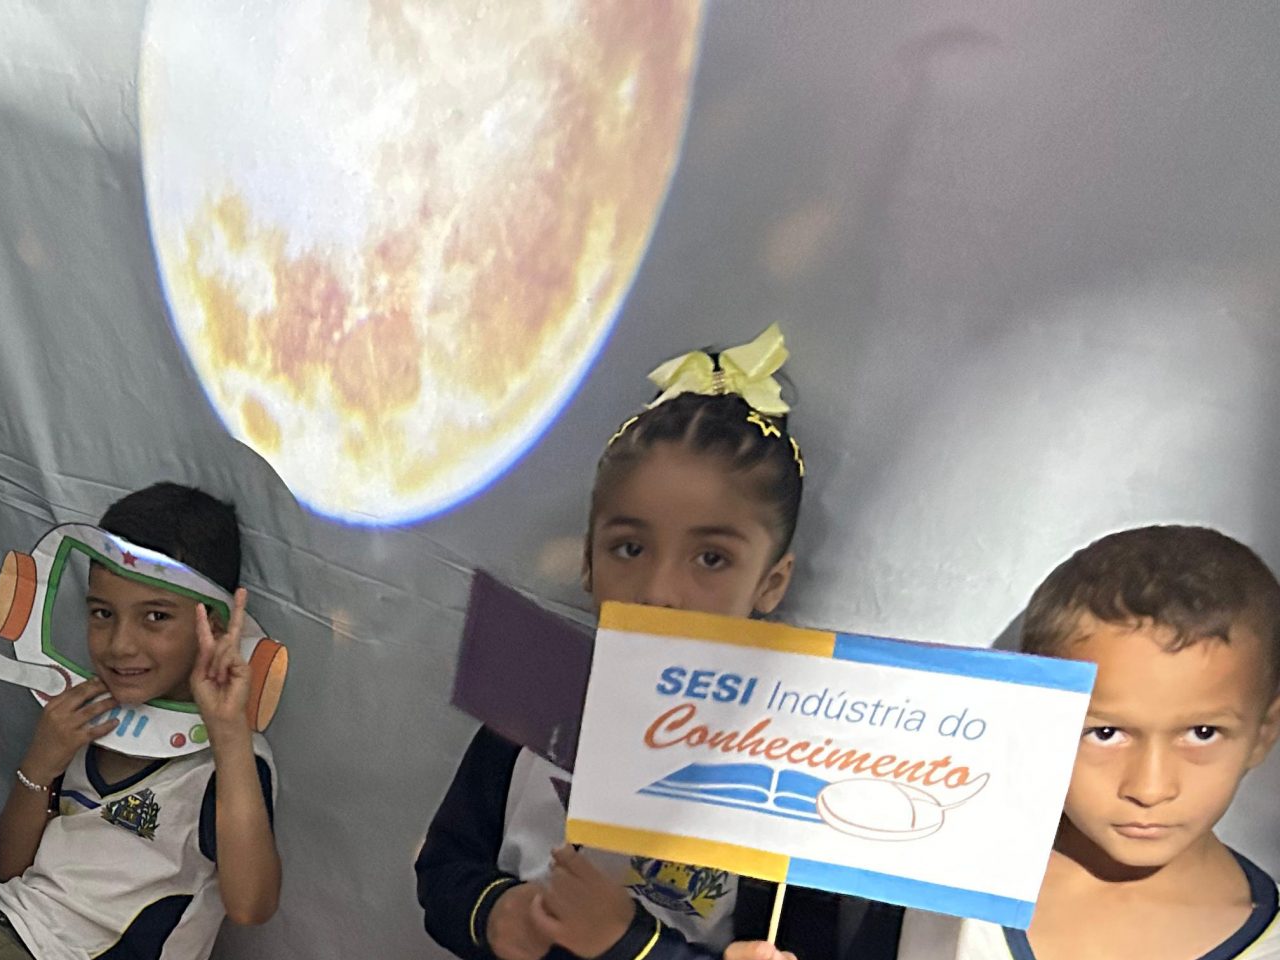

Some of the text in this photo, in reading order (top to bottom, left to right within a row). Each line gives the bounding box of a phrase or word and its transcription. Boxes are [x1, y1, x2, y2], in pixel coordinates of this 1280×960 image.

[656, 666, 987, 740] SESI Indústria do
[643, 703, 971, 789] Conhecimento
